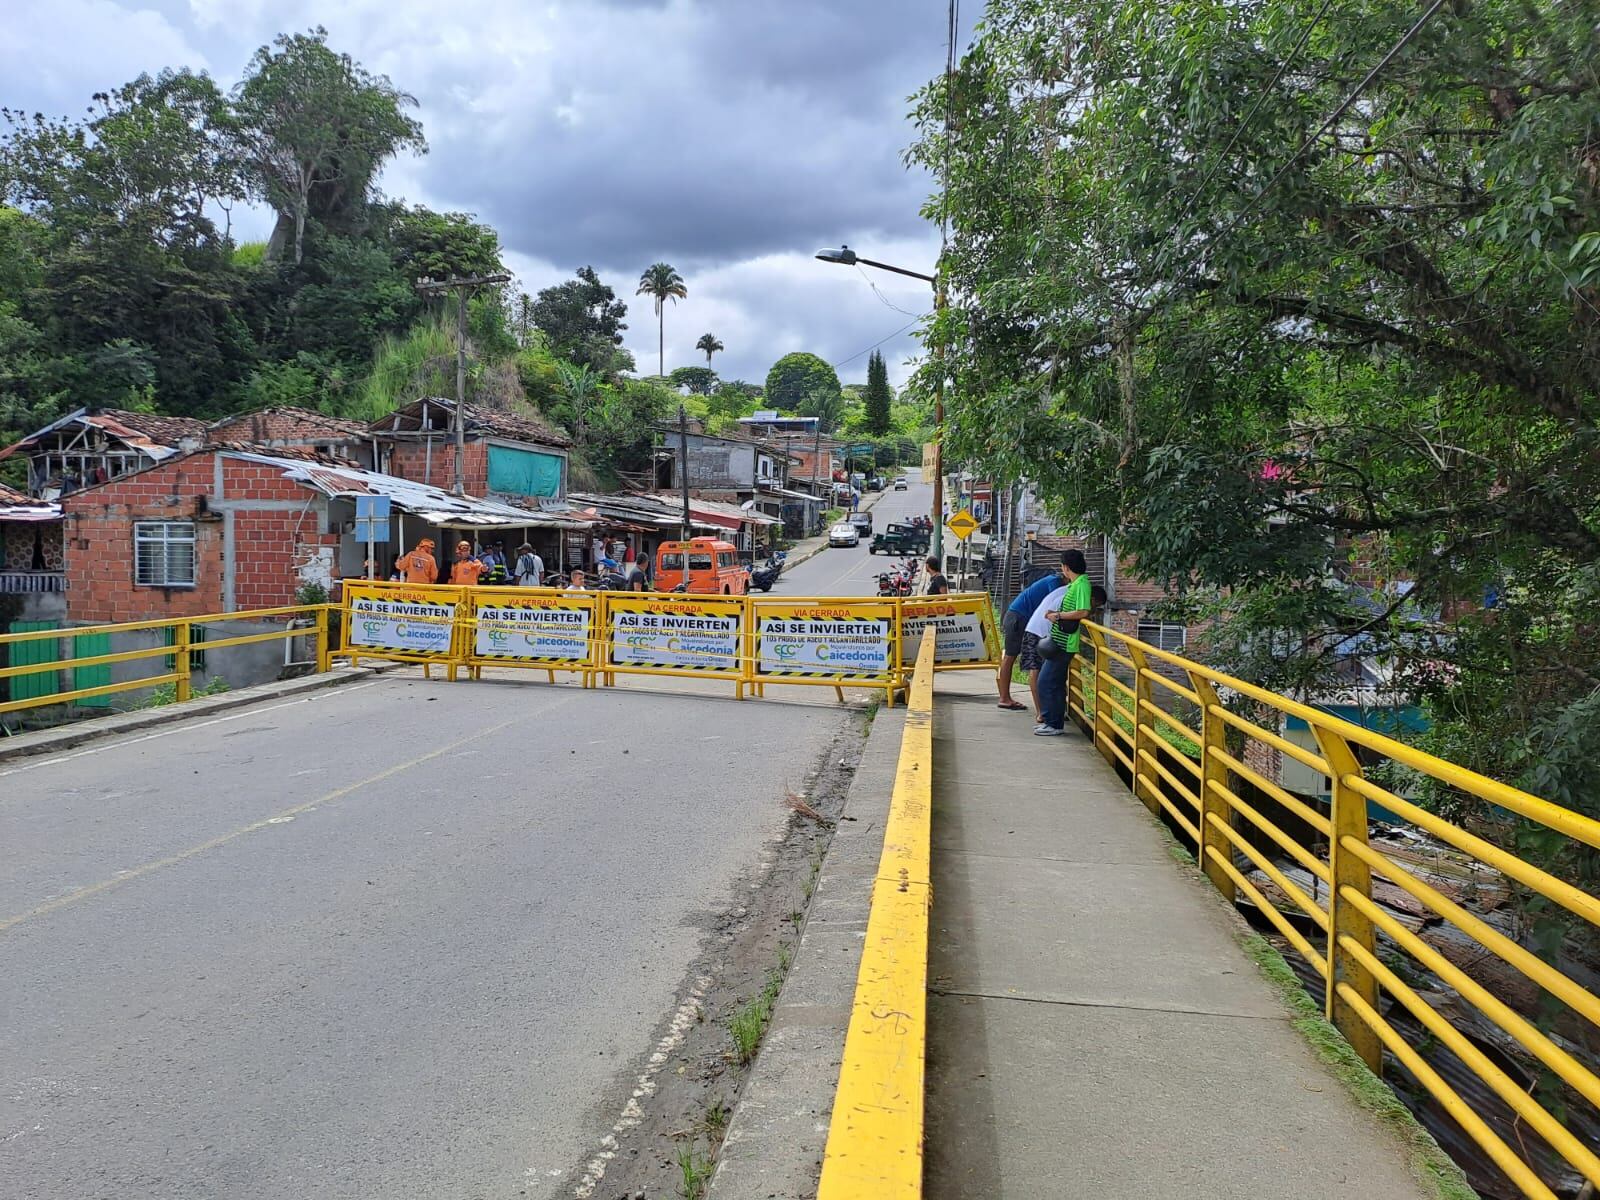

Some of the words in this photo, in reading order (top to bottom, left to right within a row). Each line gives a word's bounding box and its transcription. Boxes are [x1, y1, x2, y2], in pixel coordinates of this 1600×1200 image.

[393, 593, 427, 601] CERRADA
[376, 604, 389, 613] SE
[392, 605, 449, 617] INVIERTEN
[661, 604, 703, 613] CERRADA
[809, 609, 851, 617] CERRADA
[502, 612, 517, 621] SE
[520, 612, 582, 623] INVIERTEN
[642, 617, 658, 627] SE
[662, 618, 730, 630] INVIERTEN
[789, 624, 806, 633] SE
[809, 624, 881, 634] INVIERTEN
[816, 643, 885, 661] Caicedonia
